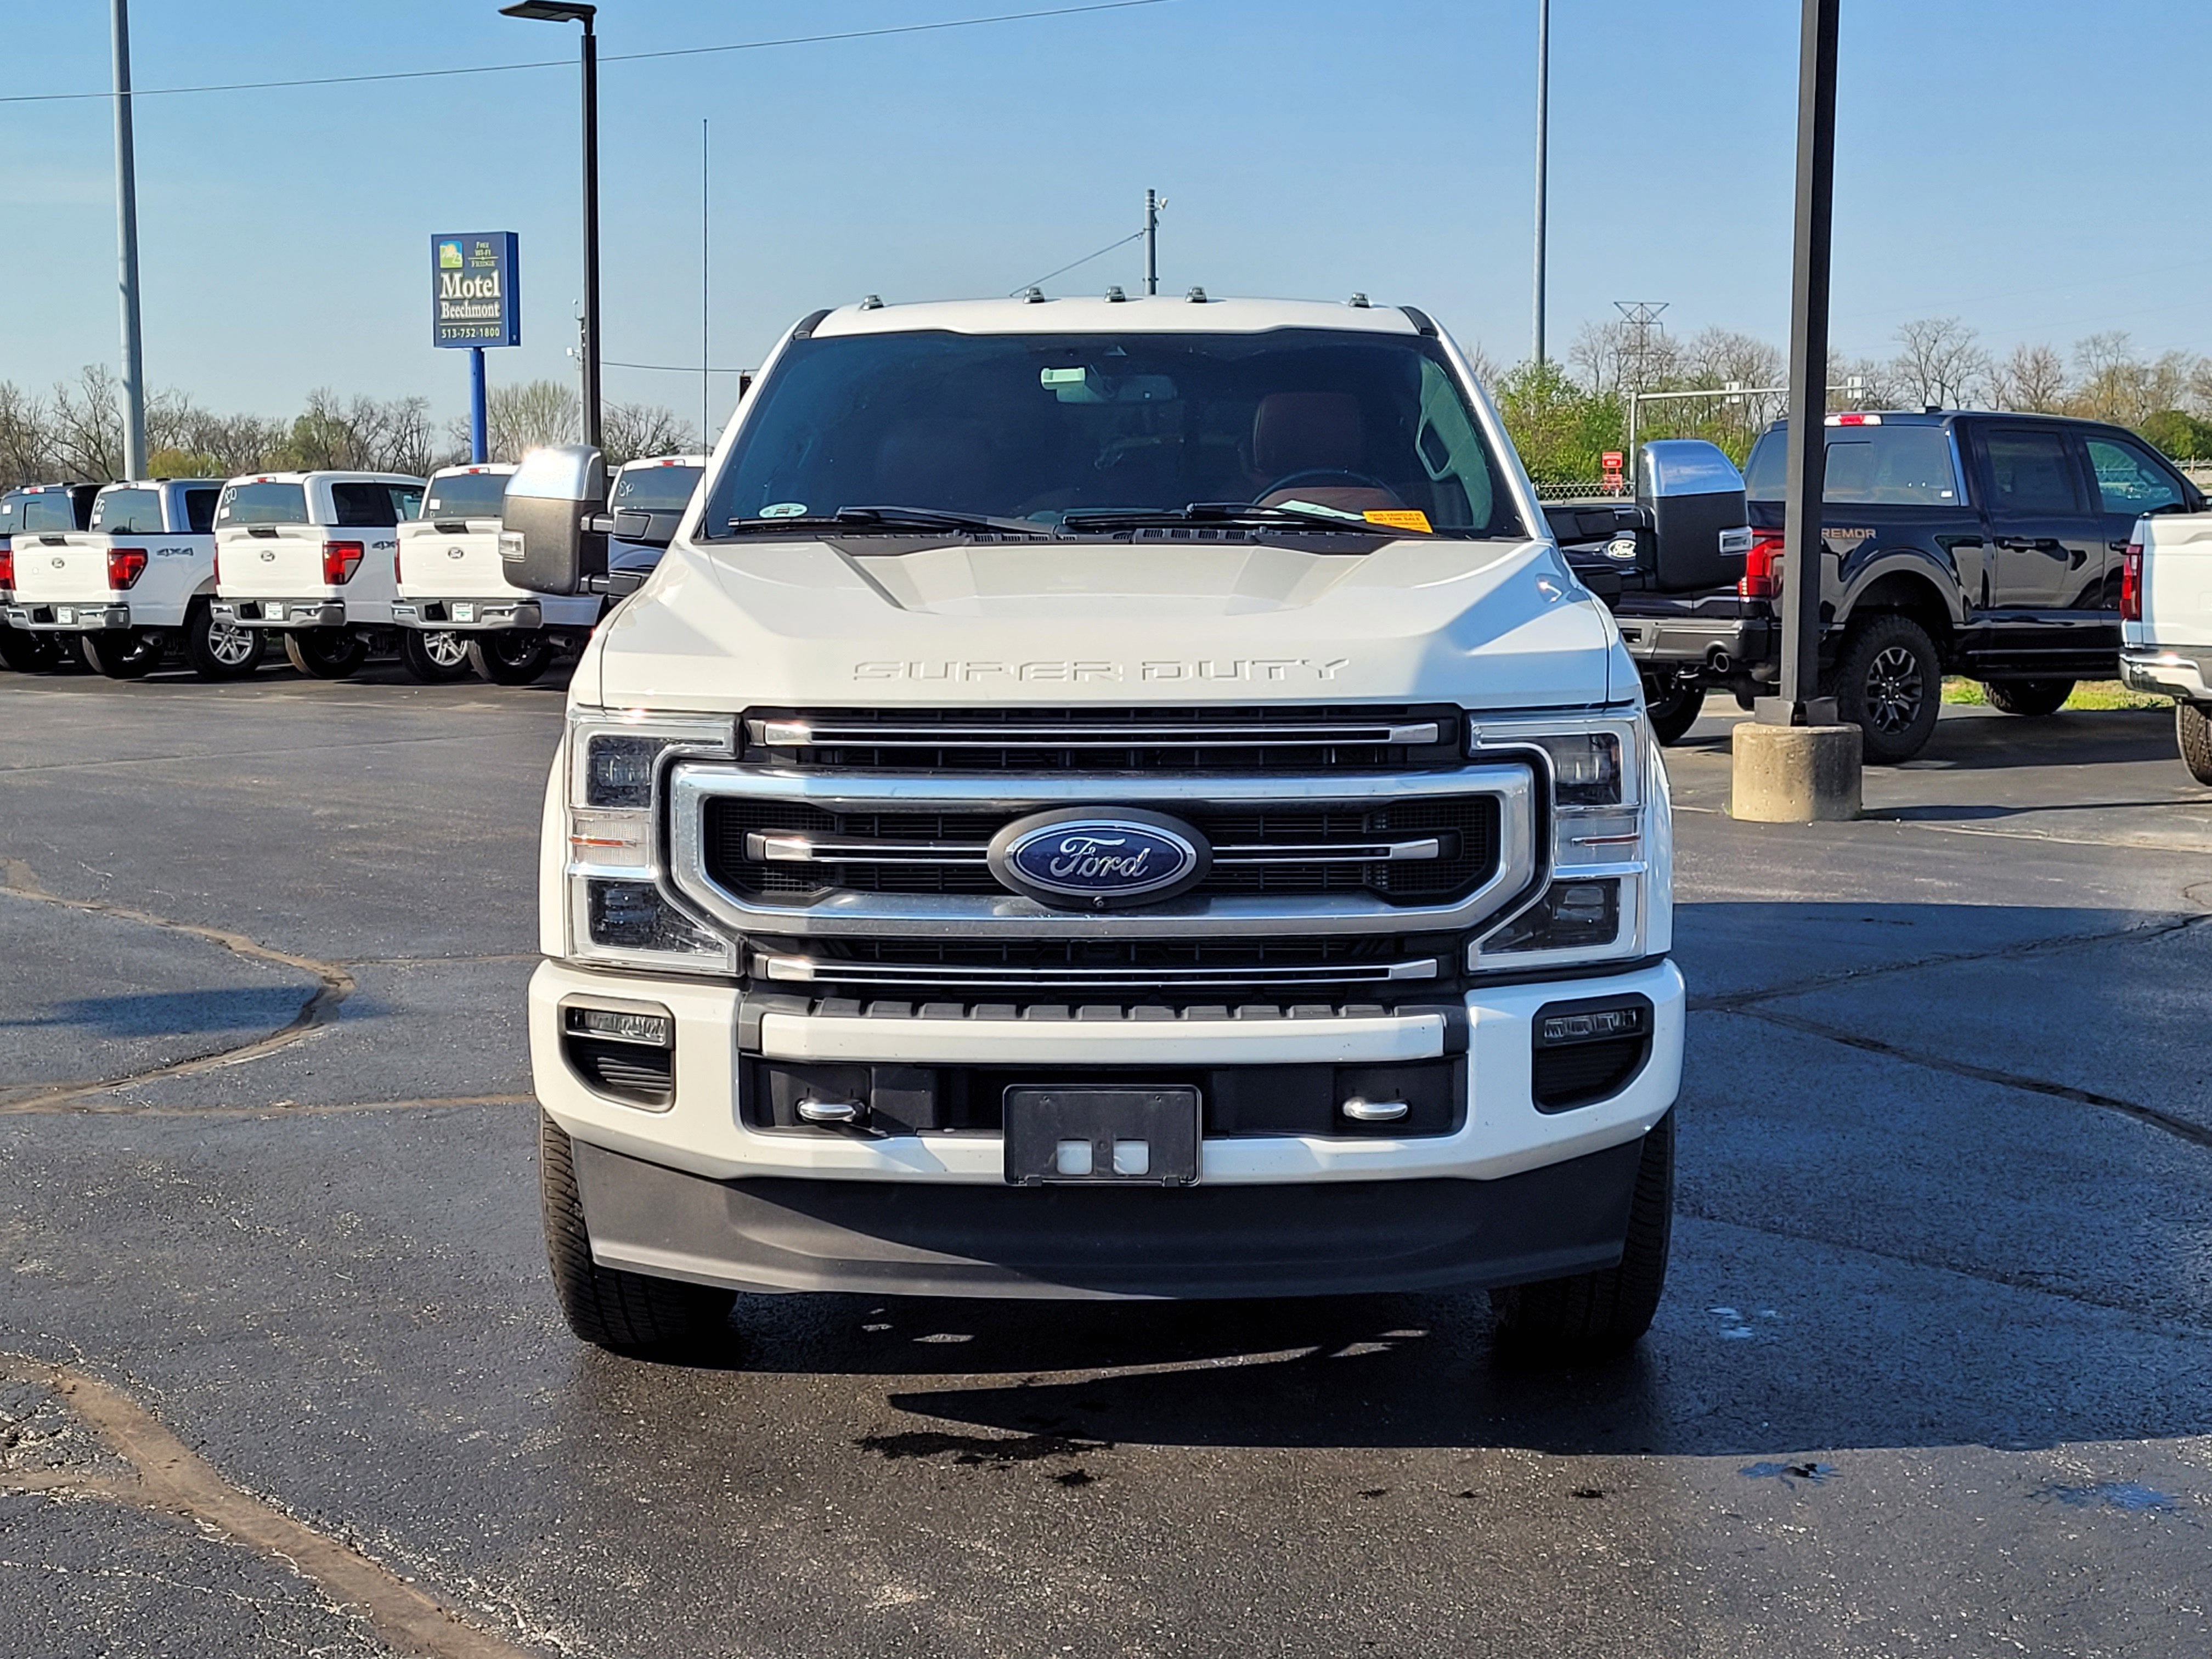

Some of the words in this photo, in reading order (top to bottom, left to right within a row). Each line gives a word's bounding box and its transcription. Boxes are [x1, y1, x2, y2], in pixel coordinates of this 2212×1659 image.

[439, 269, 501, 299] Motel
[441, 300, 501, 319] Beechmont
[1821, 528, 1876, 538] REMOR
[854, 661, 1124, 682] SUPER
[1141, 659, 1350, 681] DUTY
[1049, 836, 1151, 878] Ford
